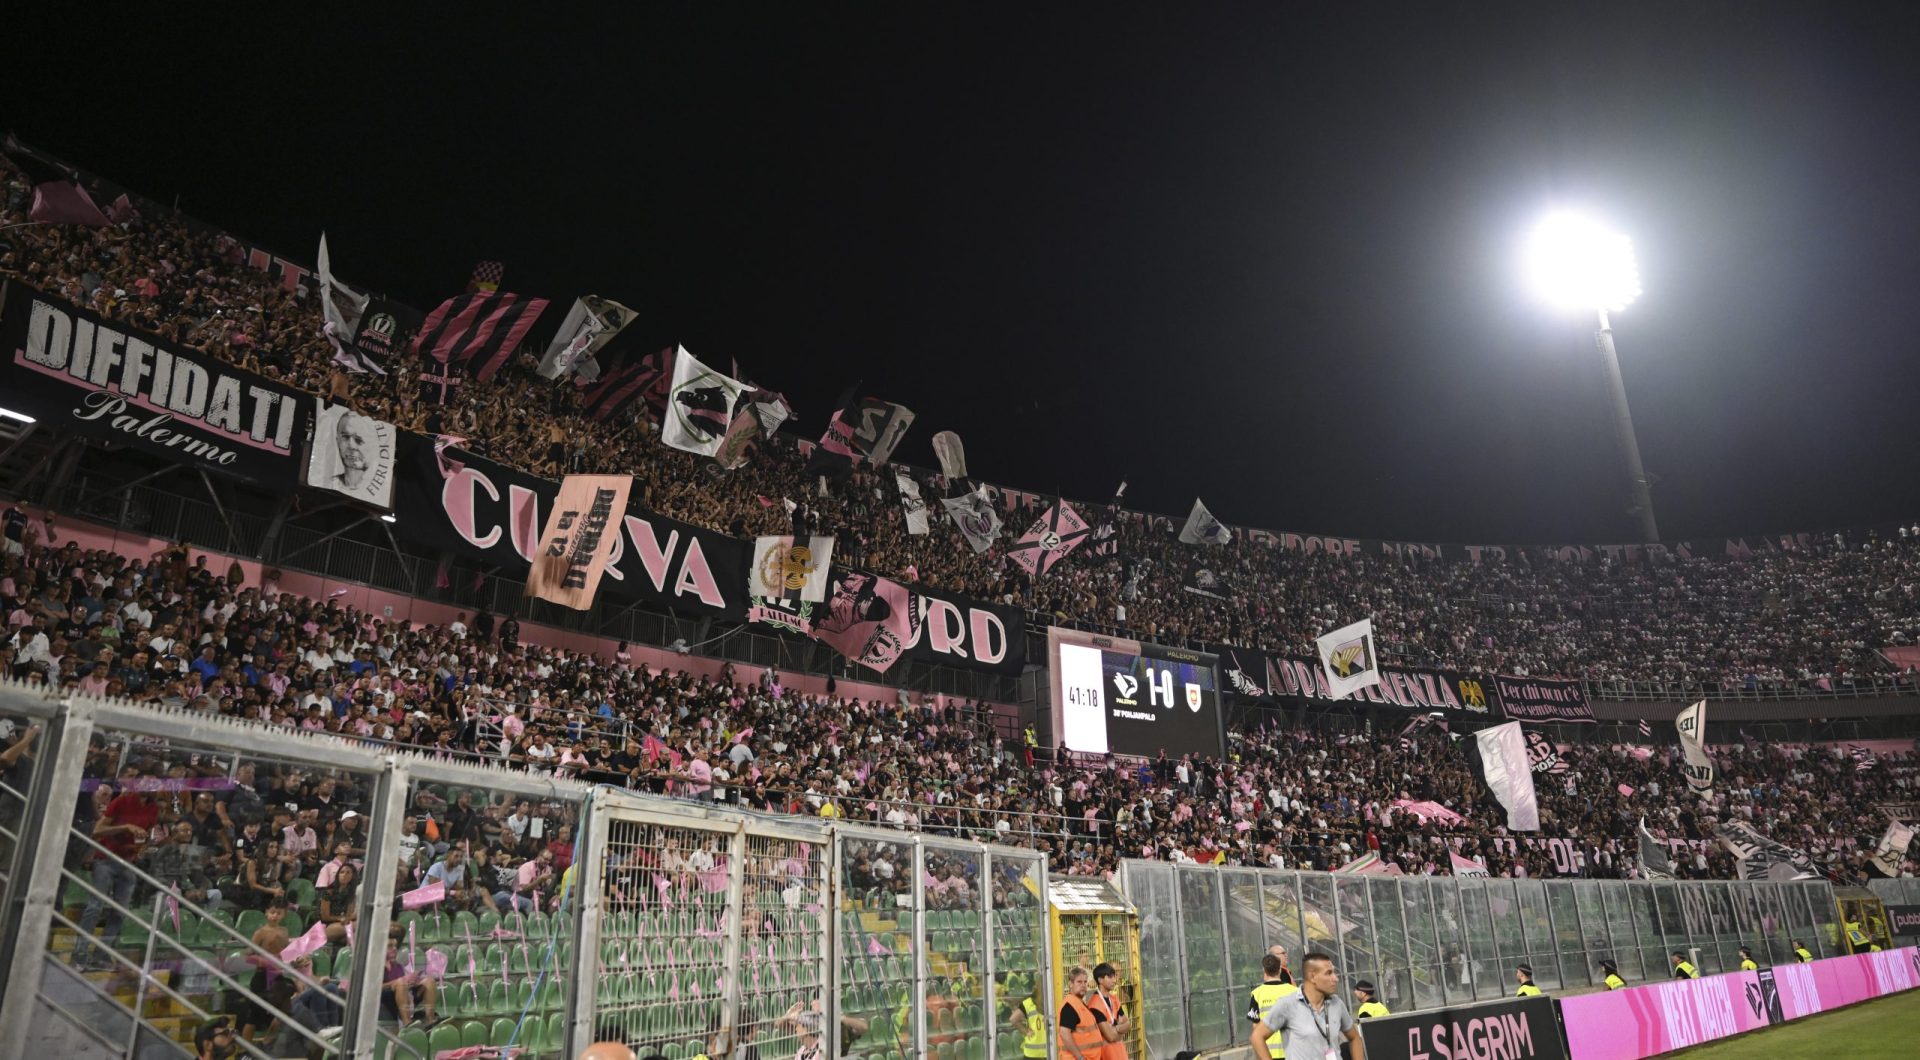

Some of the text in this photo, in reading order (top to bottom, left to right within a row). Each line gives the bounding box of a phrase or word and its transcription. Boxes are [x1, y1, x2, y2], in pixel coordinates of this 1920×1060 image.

[24, 299, 297, 450] DIFFIDATI
[72, 389, 237, 465] Palermo
[366, 463, 388, 497] FIERI
[378, 444, 390, 460] DI
[1061, 506, 1081, 531] Curva
[1043, 532, 1059, 549] 12
[1016, 550, 1036, 568] Nord
[1069, 685, 1099, 708] 41:18
[1145, 667, 1175, 709] 1-0
[1265, 656, 1462, 710] APPANENZA
[1522, 683, 1541, 700] chi
[1540, 686, 1564, 702] non
[1116, 697, 1138, 706] PALERMO
[1896, 911, 1920, 928] pubb
[1658, 975, 1738, 1050] NEXT MATCH
[1431, 1011, 1535, 1060] SAGRIM
